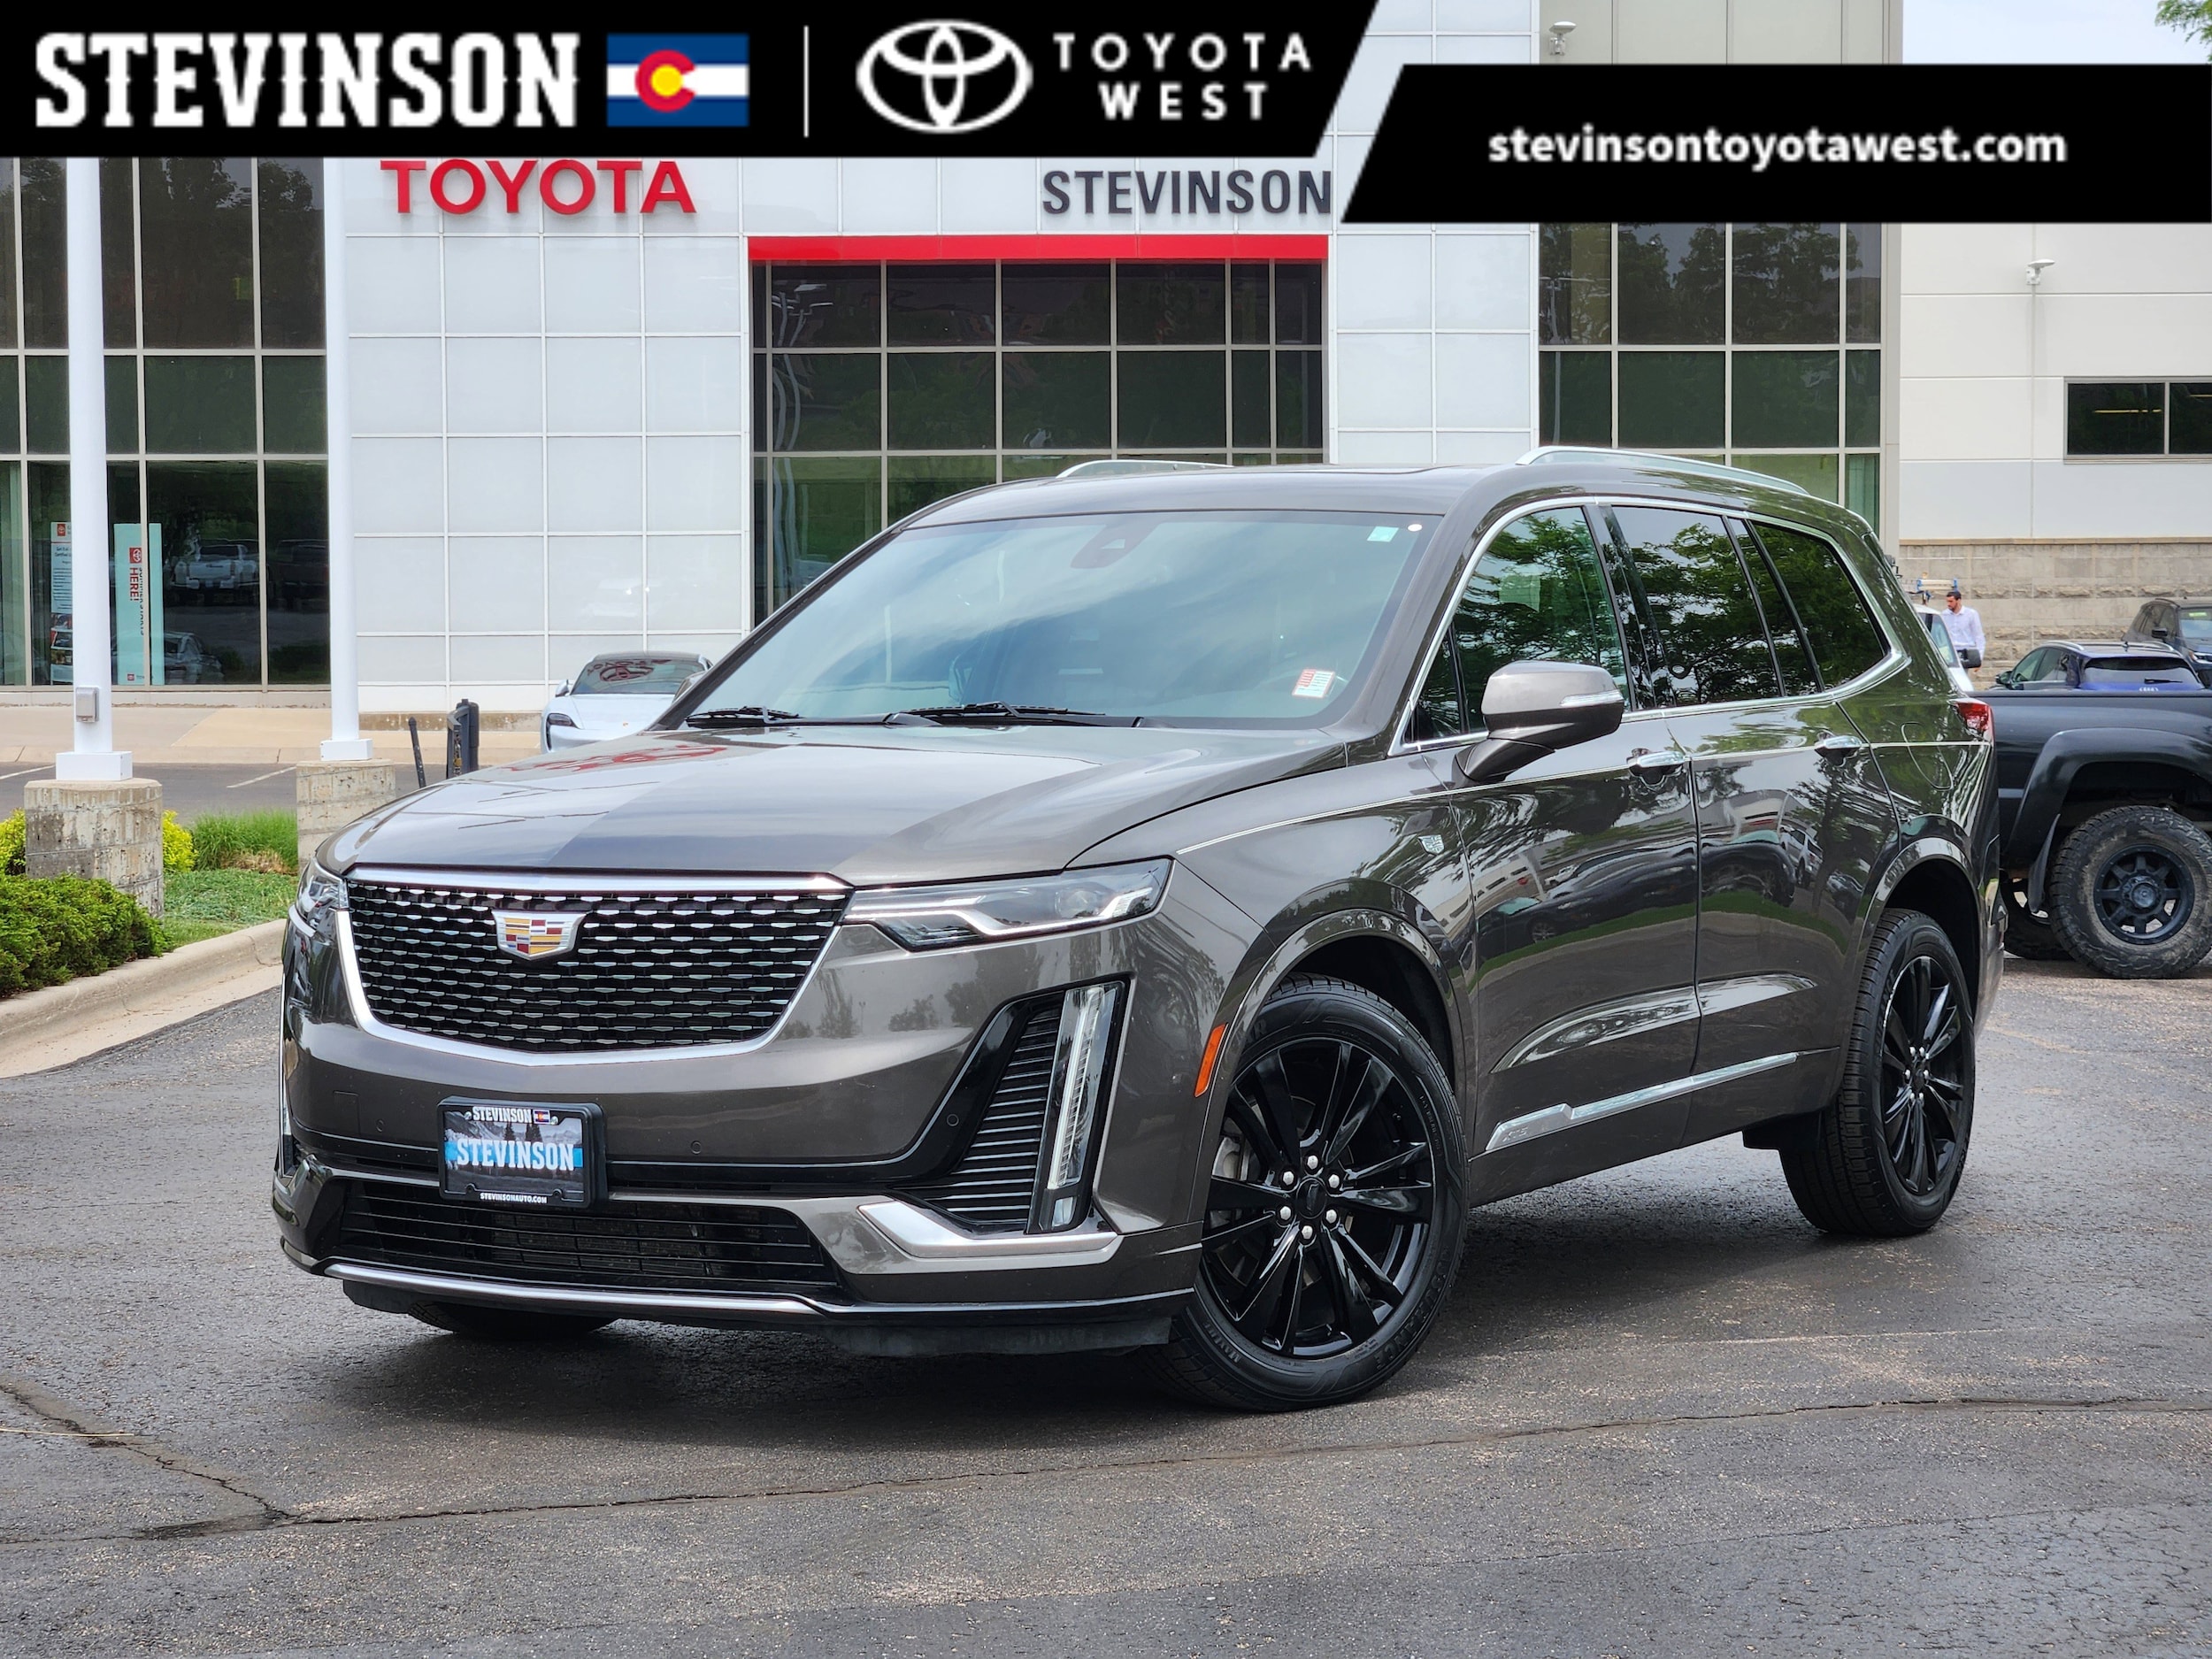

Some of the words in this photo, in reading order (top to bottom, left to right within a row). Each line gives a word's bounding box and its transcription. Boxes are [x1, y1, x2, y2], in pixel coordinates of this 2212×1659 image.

[380, 158, 696, 215] TOYOTA
[1043, 170, 1331, 215] STEVINSON
[129, 567, 140, 601] HERE!
[472, 1106, 533, 1124] STEVINSON
[457, 1138, 574, 1171] STEVINSON
[480, 1192, 548, 1204] STEVINSONAUTO.COM
